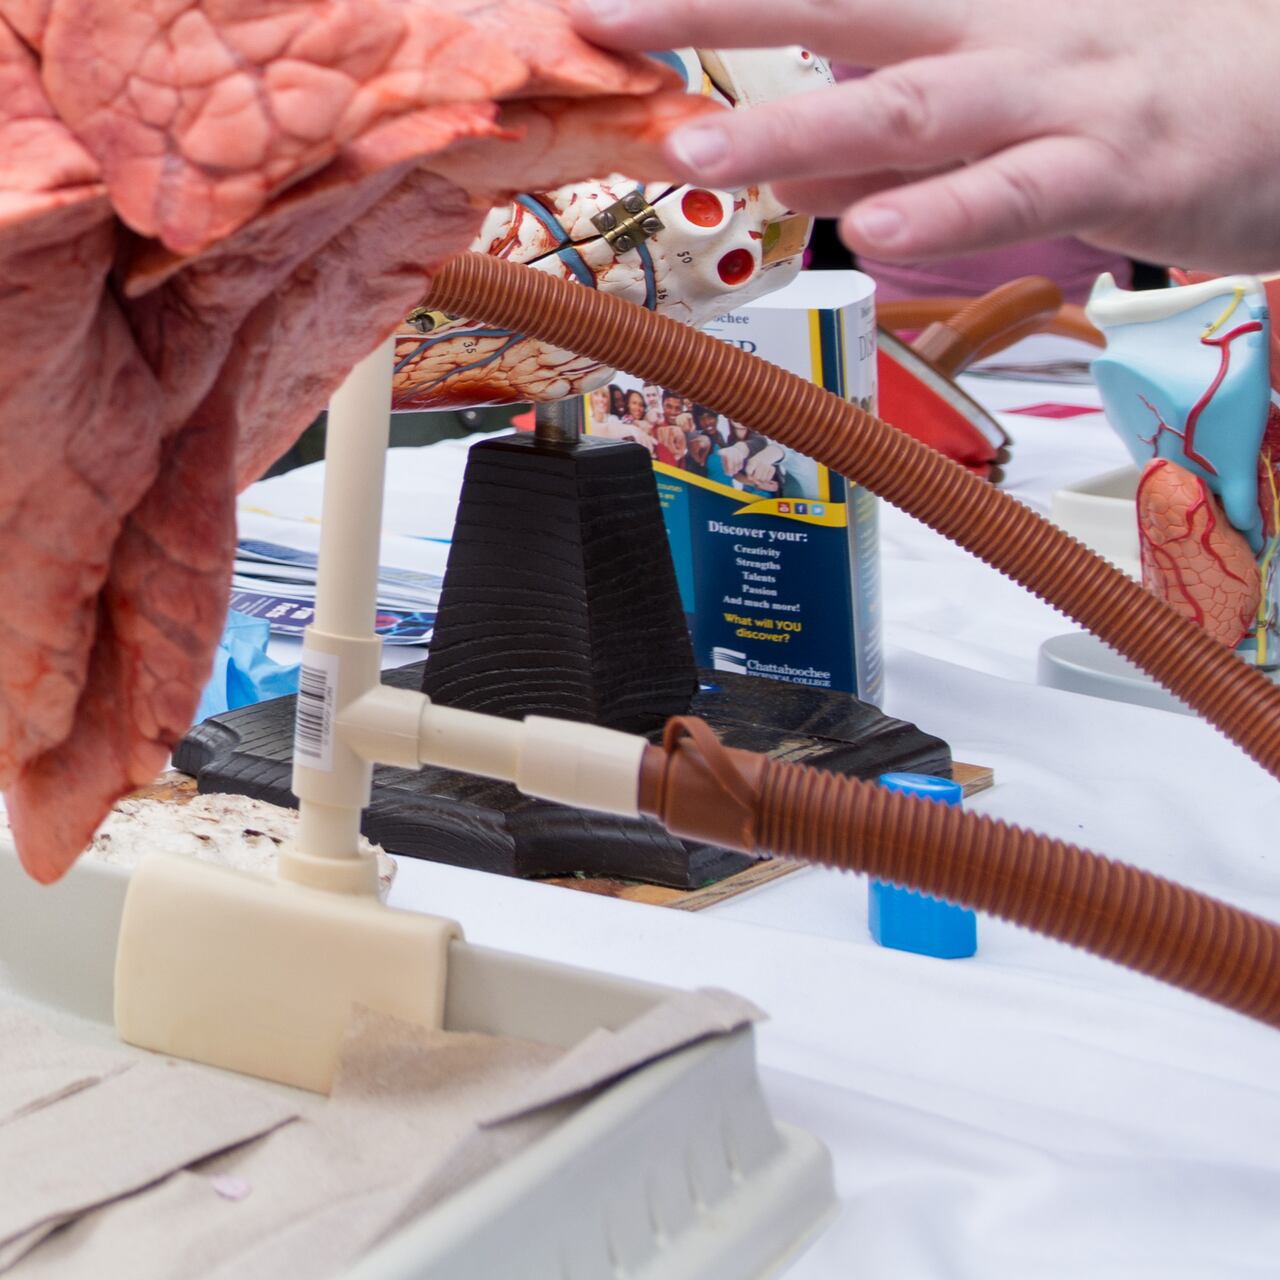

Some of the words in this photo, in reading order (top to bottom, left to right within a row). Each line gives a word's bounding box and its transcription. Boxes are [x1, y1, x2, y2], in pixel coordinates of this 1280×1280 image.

[677, 251, 693, 264] 50
[463, 342, 477, 354] 35
[708, 520, 765, 538] Discover
[768, 530, 808, 543] your:
[733, 543, 781, 559] Creativity
[735, 557, 781, 571] Strengths
[741, 571, 776, 583] Talents
[741, 584, 778, 597] Passion
[722, 595, 743, 605] And
[743, 599, 770, 609] much
[772, 603, 801, 612] more!
[723, 612, 753, 627] What
[755, 619, 774, 629] will
[775, 620, 802, 632] YOU
[736, 628, 790, 643] discover?
[746, 659, 831, 680] Chattahoochee
[792, 677, 832, 688] COLLEGE
